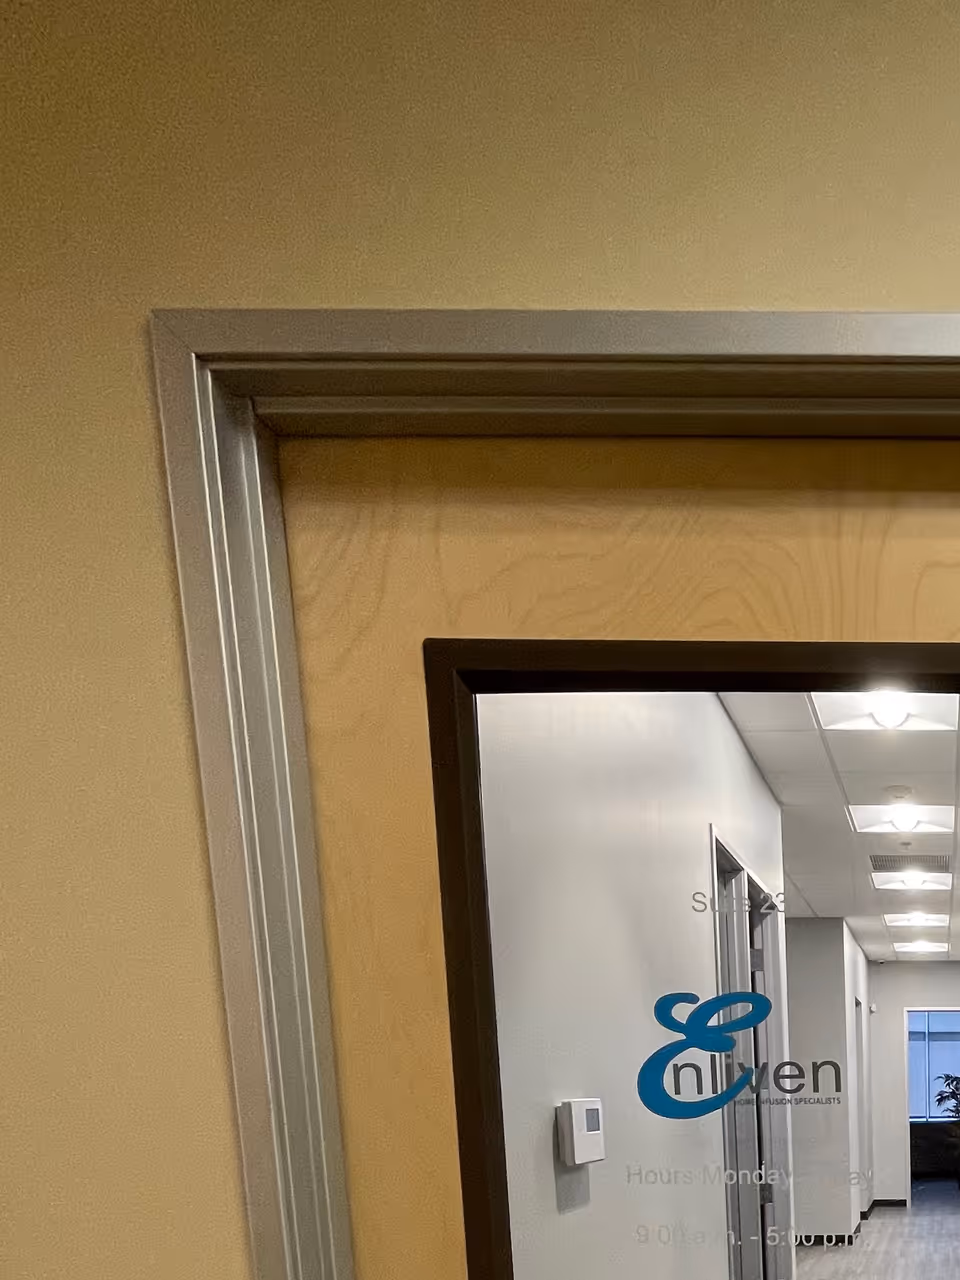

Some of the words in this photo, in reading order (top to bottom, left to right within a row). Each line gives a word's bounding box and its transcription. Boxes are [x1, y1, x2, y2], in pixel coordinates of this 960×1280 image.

[636, 990, 842, 1120] Enliven
[758, 1097, 793, 1107] NFUSION
[794, 1096, 842, 1106] SPECIALISTS
[702, 1161, 793, 1191] Monday
